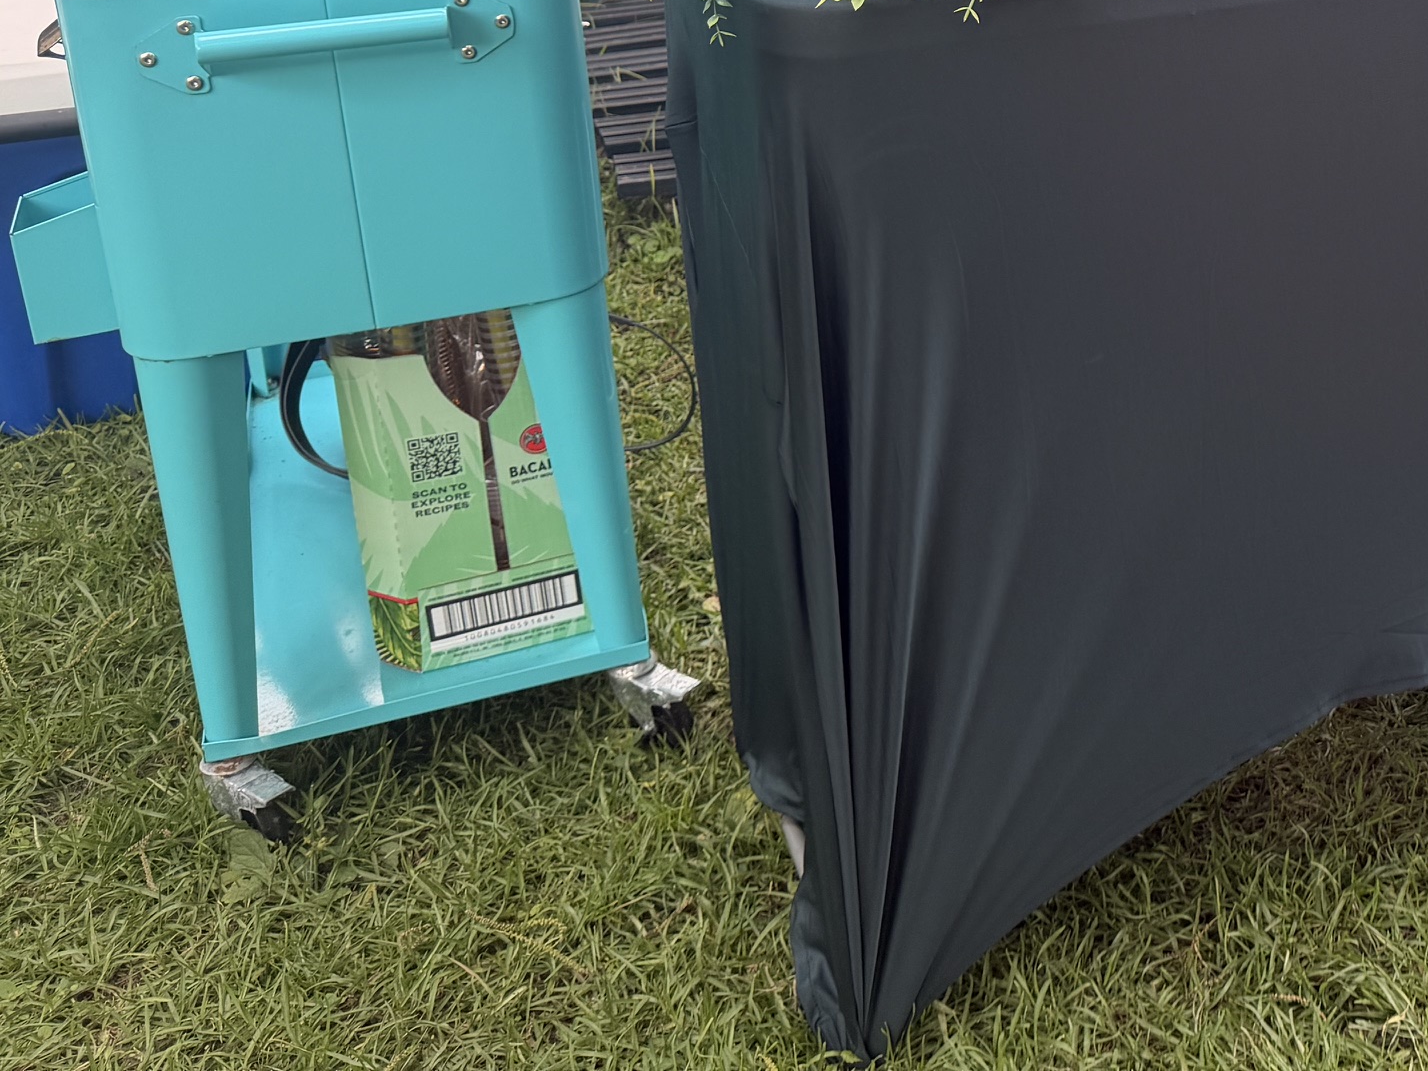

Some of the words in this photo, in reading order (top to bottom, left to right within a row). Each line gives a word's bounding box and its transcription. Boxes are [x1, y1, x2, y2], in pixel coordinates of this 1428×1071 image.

[412, 486, 447, 499] SCAN
[449, 482, 467, 492] TO
[411, 491, 471, 509] EXPLORE
[415, 501, 469, 518] RECIPES
